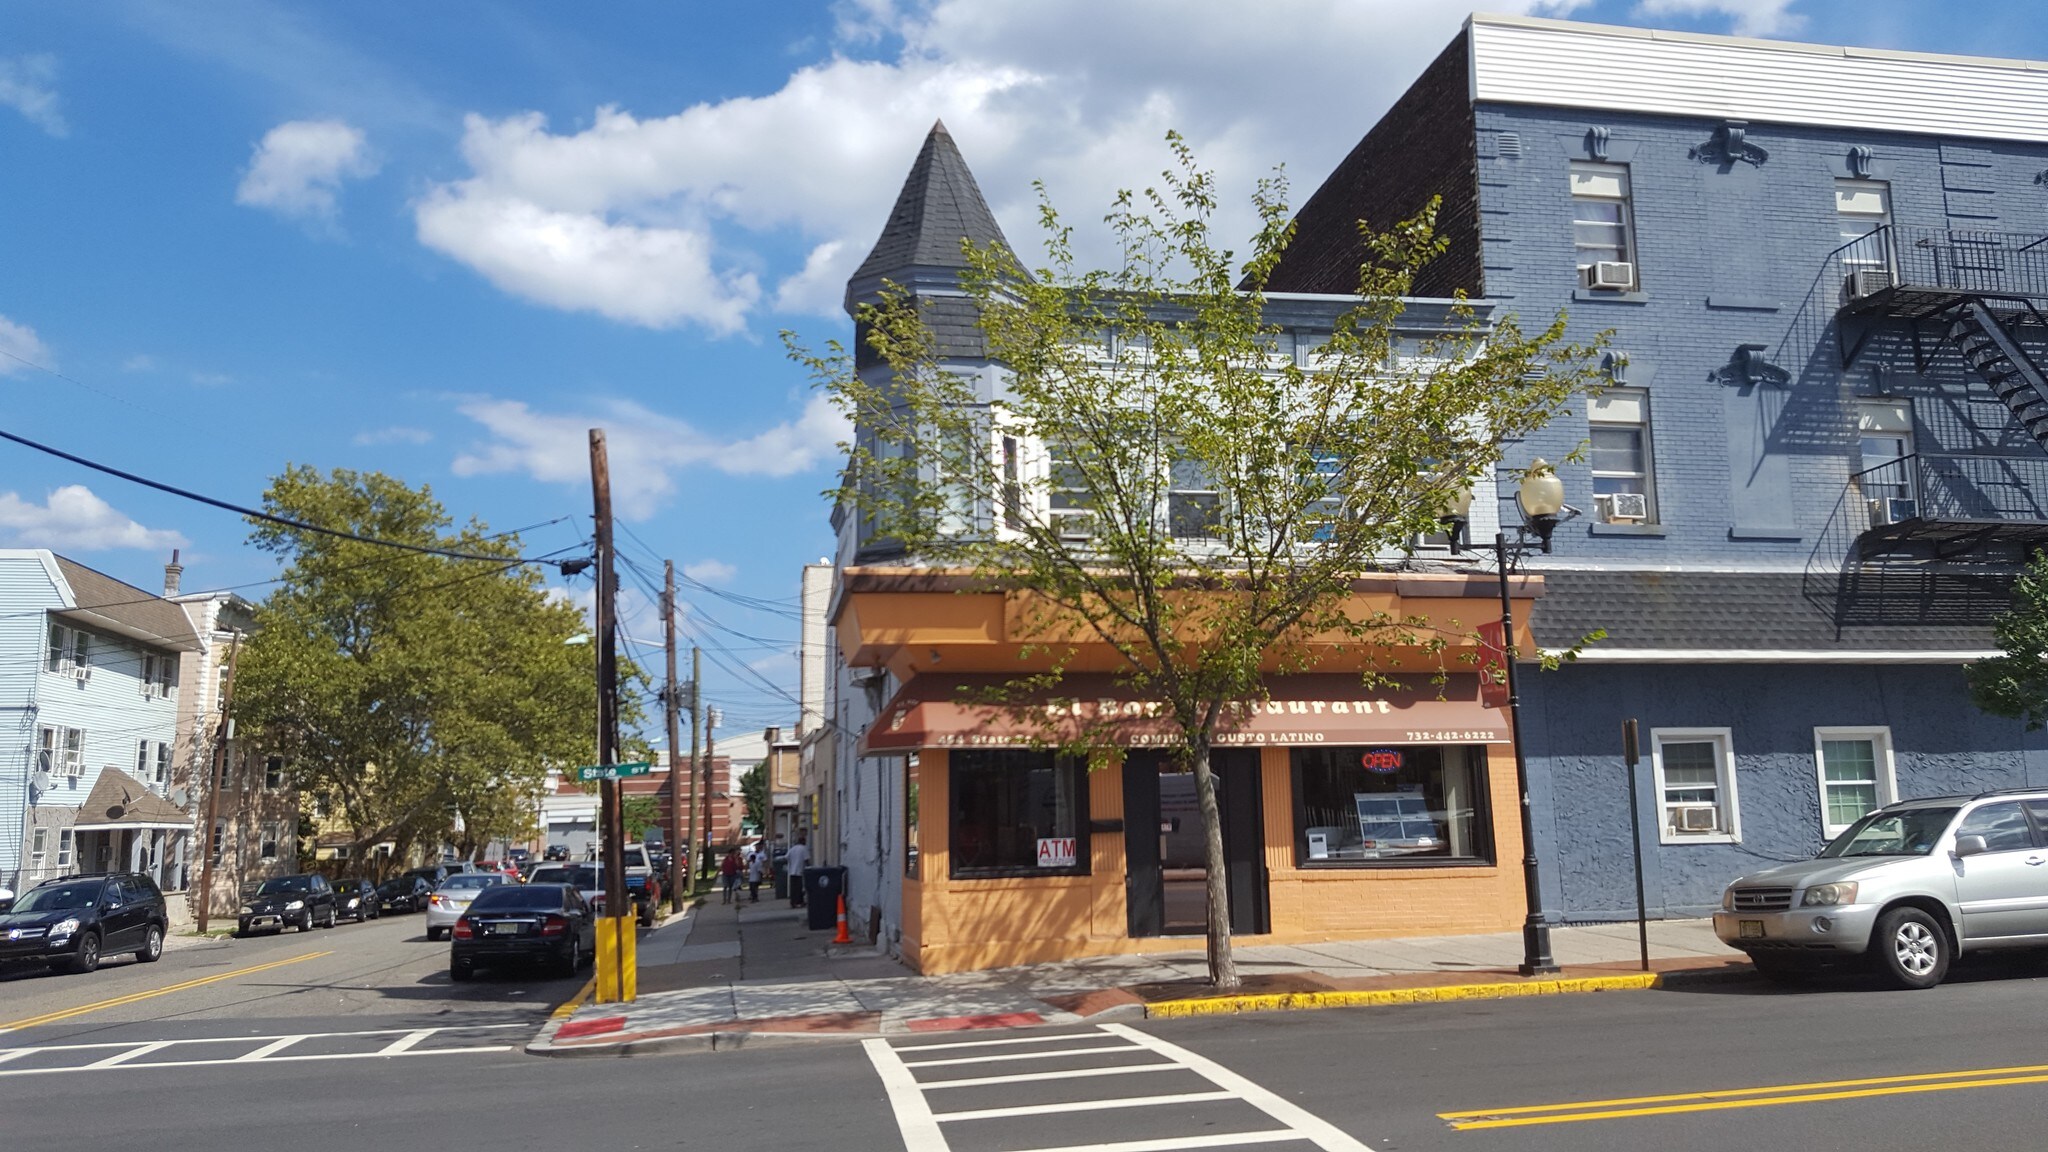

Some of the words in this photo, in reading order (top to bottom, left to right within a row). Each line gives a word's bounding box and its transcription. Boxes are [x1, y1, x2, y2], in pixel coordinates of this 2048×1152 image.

[1188, 698, 1391, 716] staurant
[971, 734, 1011, 745] State
[1216, 732, 1266, 743] GUSTO
[1270, 732, 1325, 742] LATINO
[1406, 731, 1495, 741] 732-442-6222
[1362, 752, 1401, 769] OPEN
[583, 767, 617, 779] State
[1039, 840, 1075, 858] ATM
